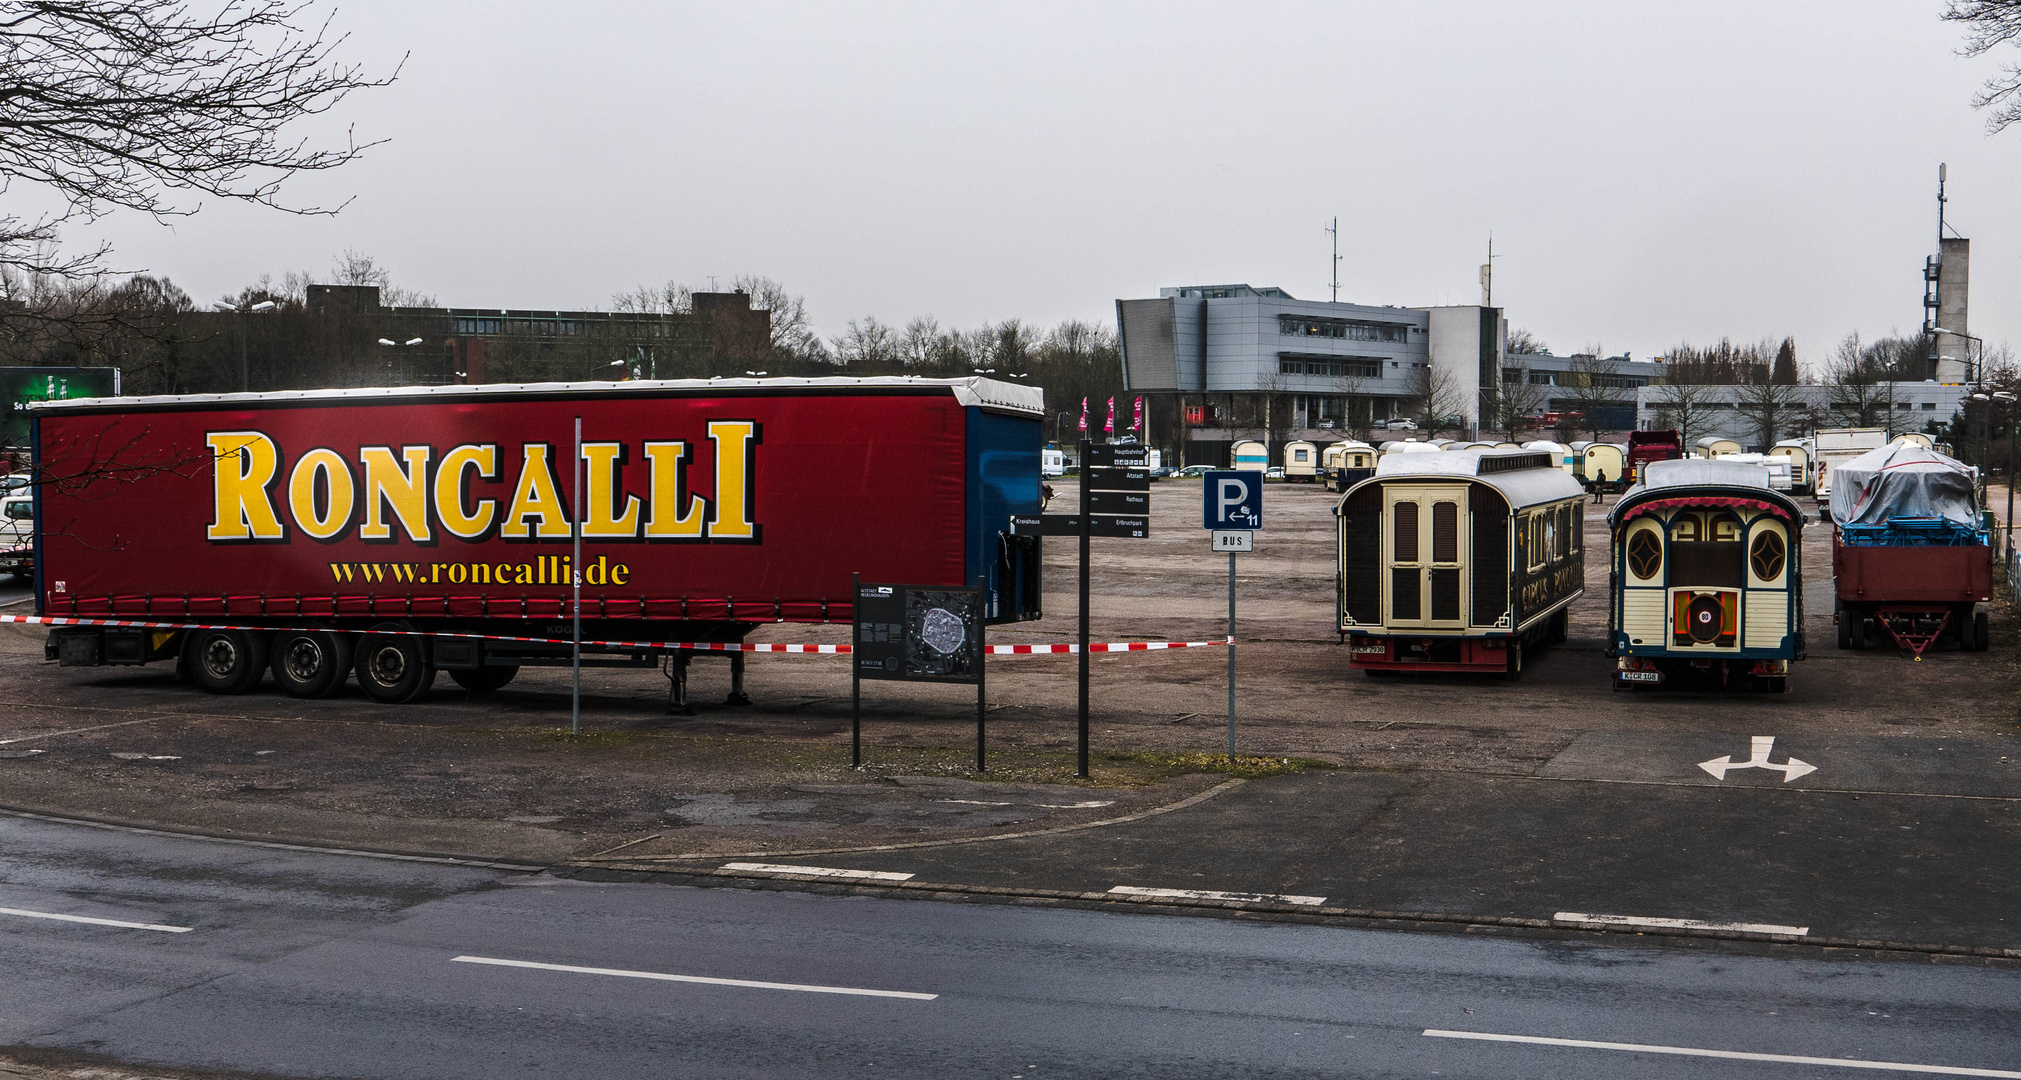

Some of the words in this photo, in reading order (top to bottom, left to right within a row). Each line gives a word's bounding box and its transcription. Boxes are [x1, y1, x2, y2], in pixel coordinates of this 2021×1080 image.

[14, 402, 23, 410] So
[1114, 448, 1144, 456] Hauptbahnhof
[205, 421, 757, 542] RONCALLI
[1217, 479, 1249, 522] P
[1015, 517, 1041, 525] Kreishaus
[1115, 518, 1143, 527] Erlbruchpark
[1246, 514, 1258, 526] 11
[1222, 536, 1243, 546] BUS
[1701, 613, 1709, 621] 80
[546, 625, 587, 634] KÖGL
[1643, 673, 1656, 681] 108
